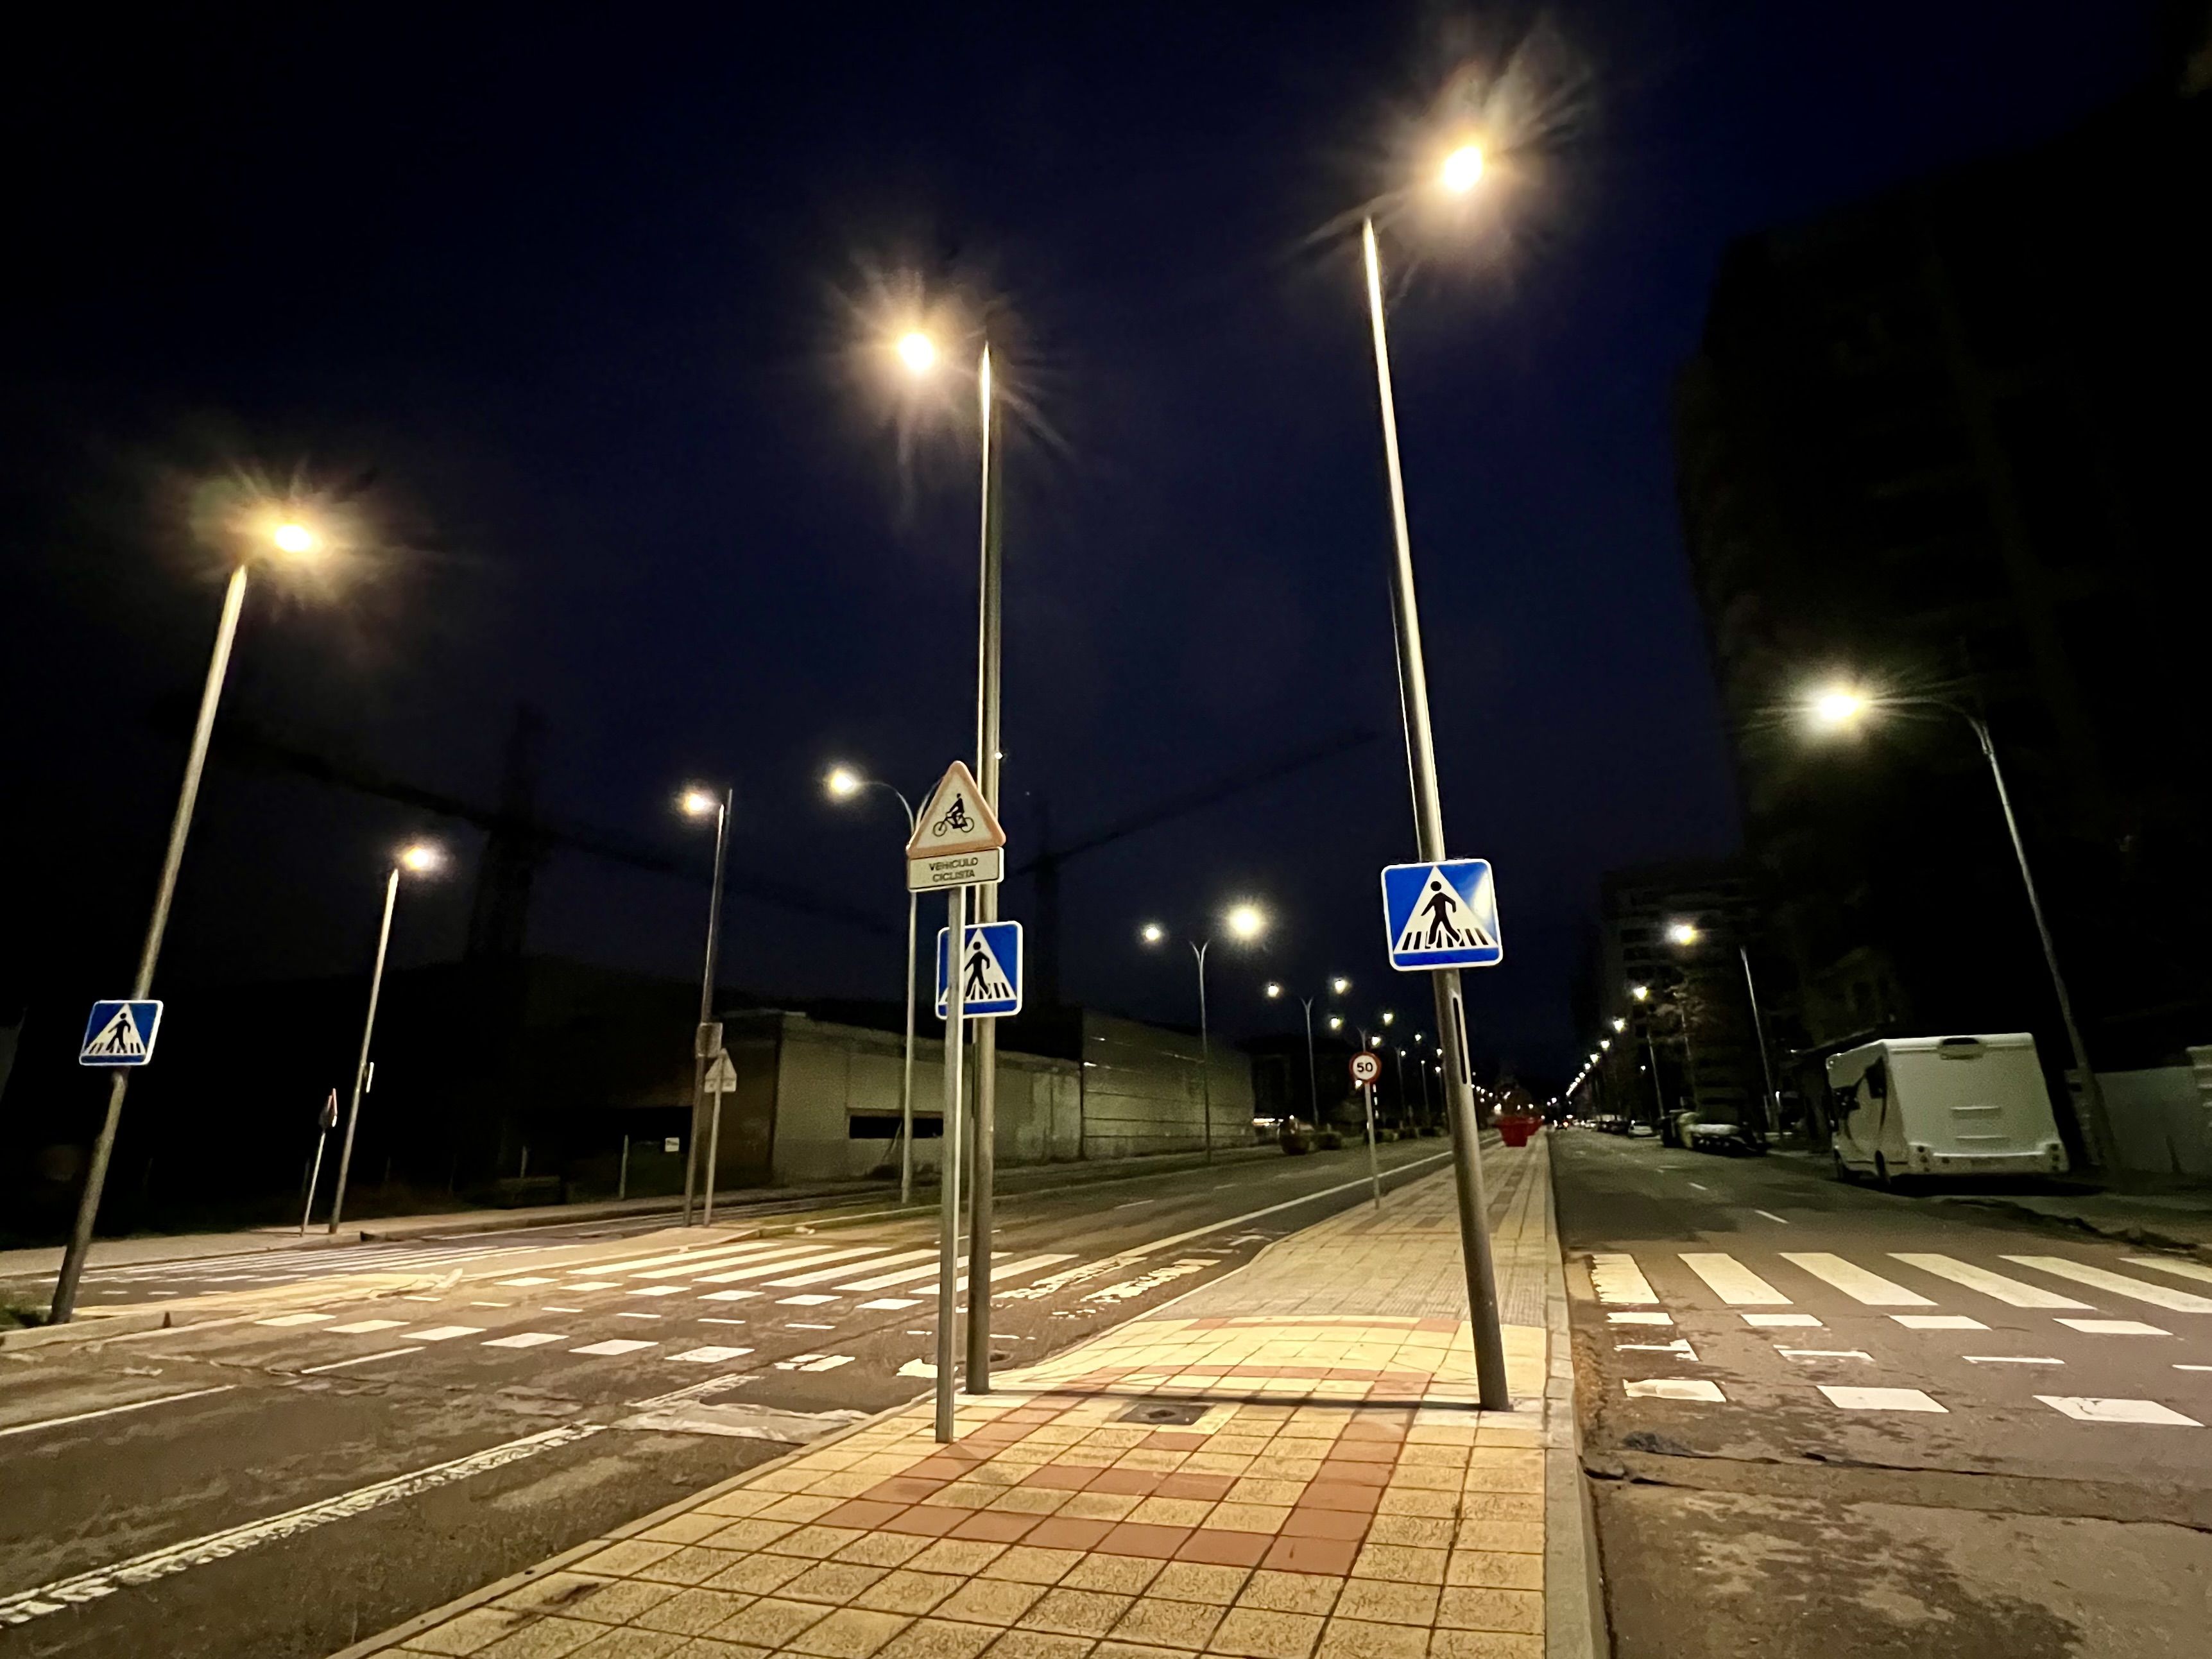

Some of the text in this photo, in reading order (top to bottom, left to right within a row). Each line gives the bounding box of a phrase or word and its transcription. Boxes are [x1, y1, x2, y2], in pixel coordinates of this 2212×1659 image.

[929, 857, 978, 870] VEHICULO
[933, 870, 975, 882] CICLISTA
[1357, 1062, 1373, 1072] 50
